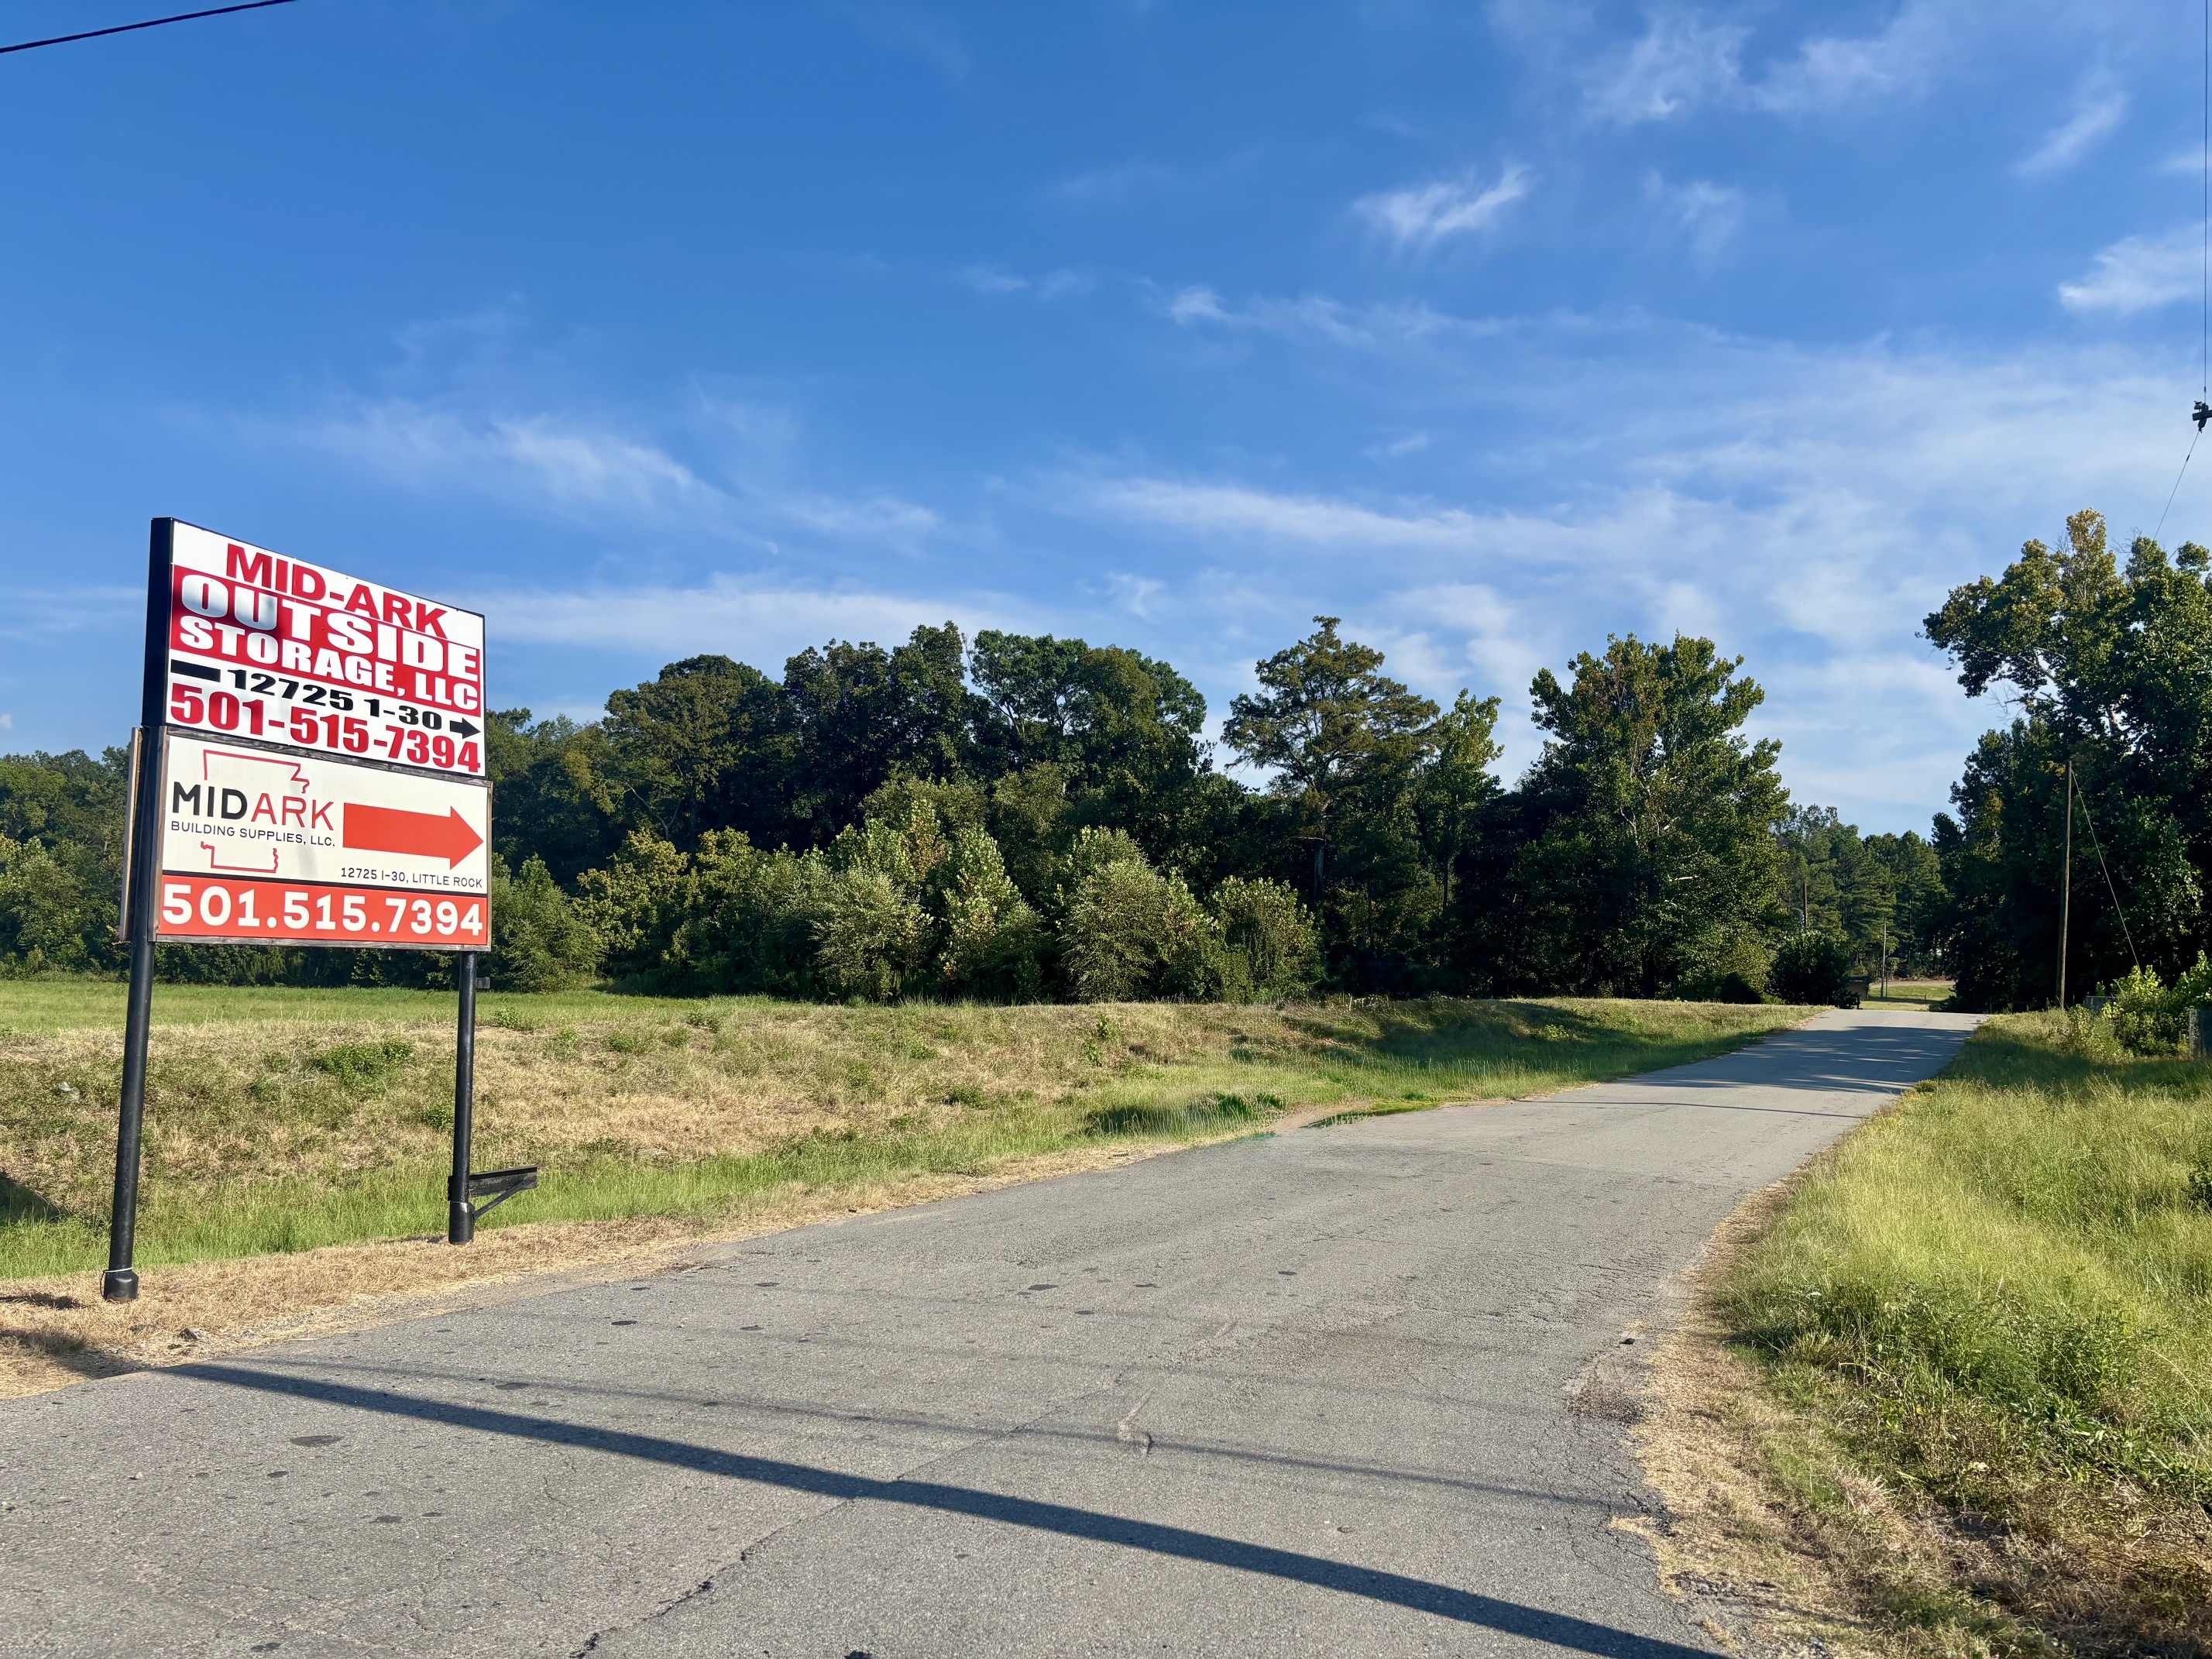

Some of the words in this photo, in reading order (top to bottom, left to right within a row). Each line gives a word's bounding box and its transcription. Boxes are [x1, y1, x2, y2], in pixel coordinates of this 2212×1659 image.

[226, 543, 448, 640] MID-ARK
[180, 616, 404, 697] STORAGE,
[415, 673, 478, 710] LLC
[181, 574, 478, 683] OUTSIDE
[228, 669, 353, 711] 12725
[170, 682, 480, 773] 501-515-7394
[171, 821, 235, 836] BUILDING
[239, 829, 306, 846] SUPPLIES,
[310, 835, 335, 847] LLC.
[162, 883, 483, 936] 501.515.7394
[341, 867, 378, 880] 12725
[381, 871, 409, 884] I-30,
[413, 873, 449, 886] LITTLE
[453, 876, 483, 888] ROCK
